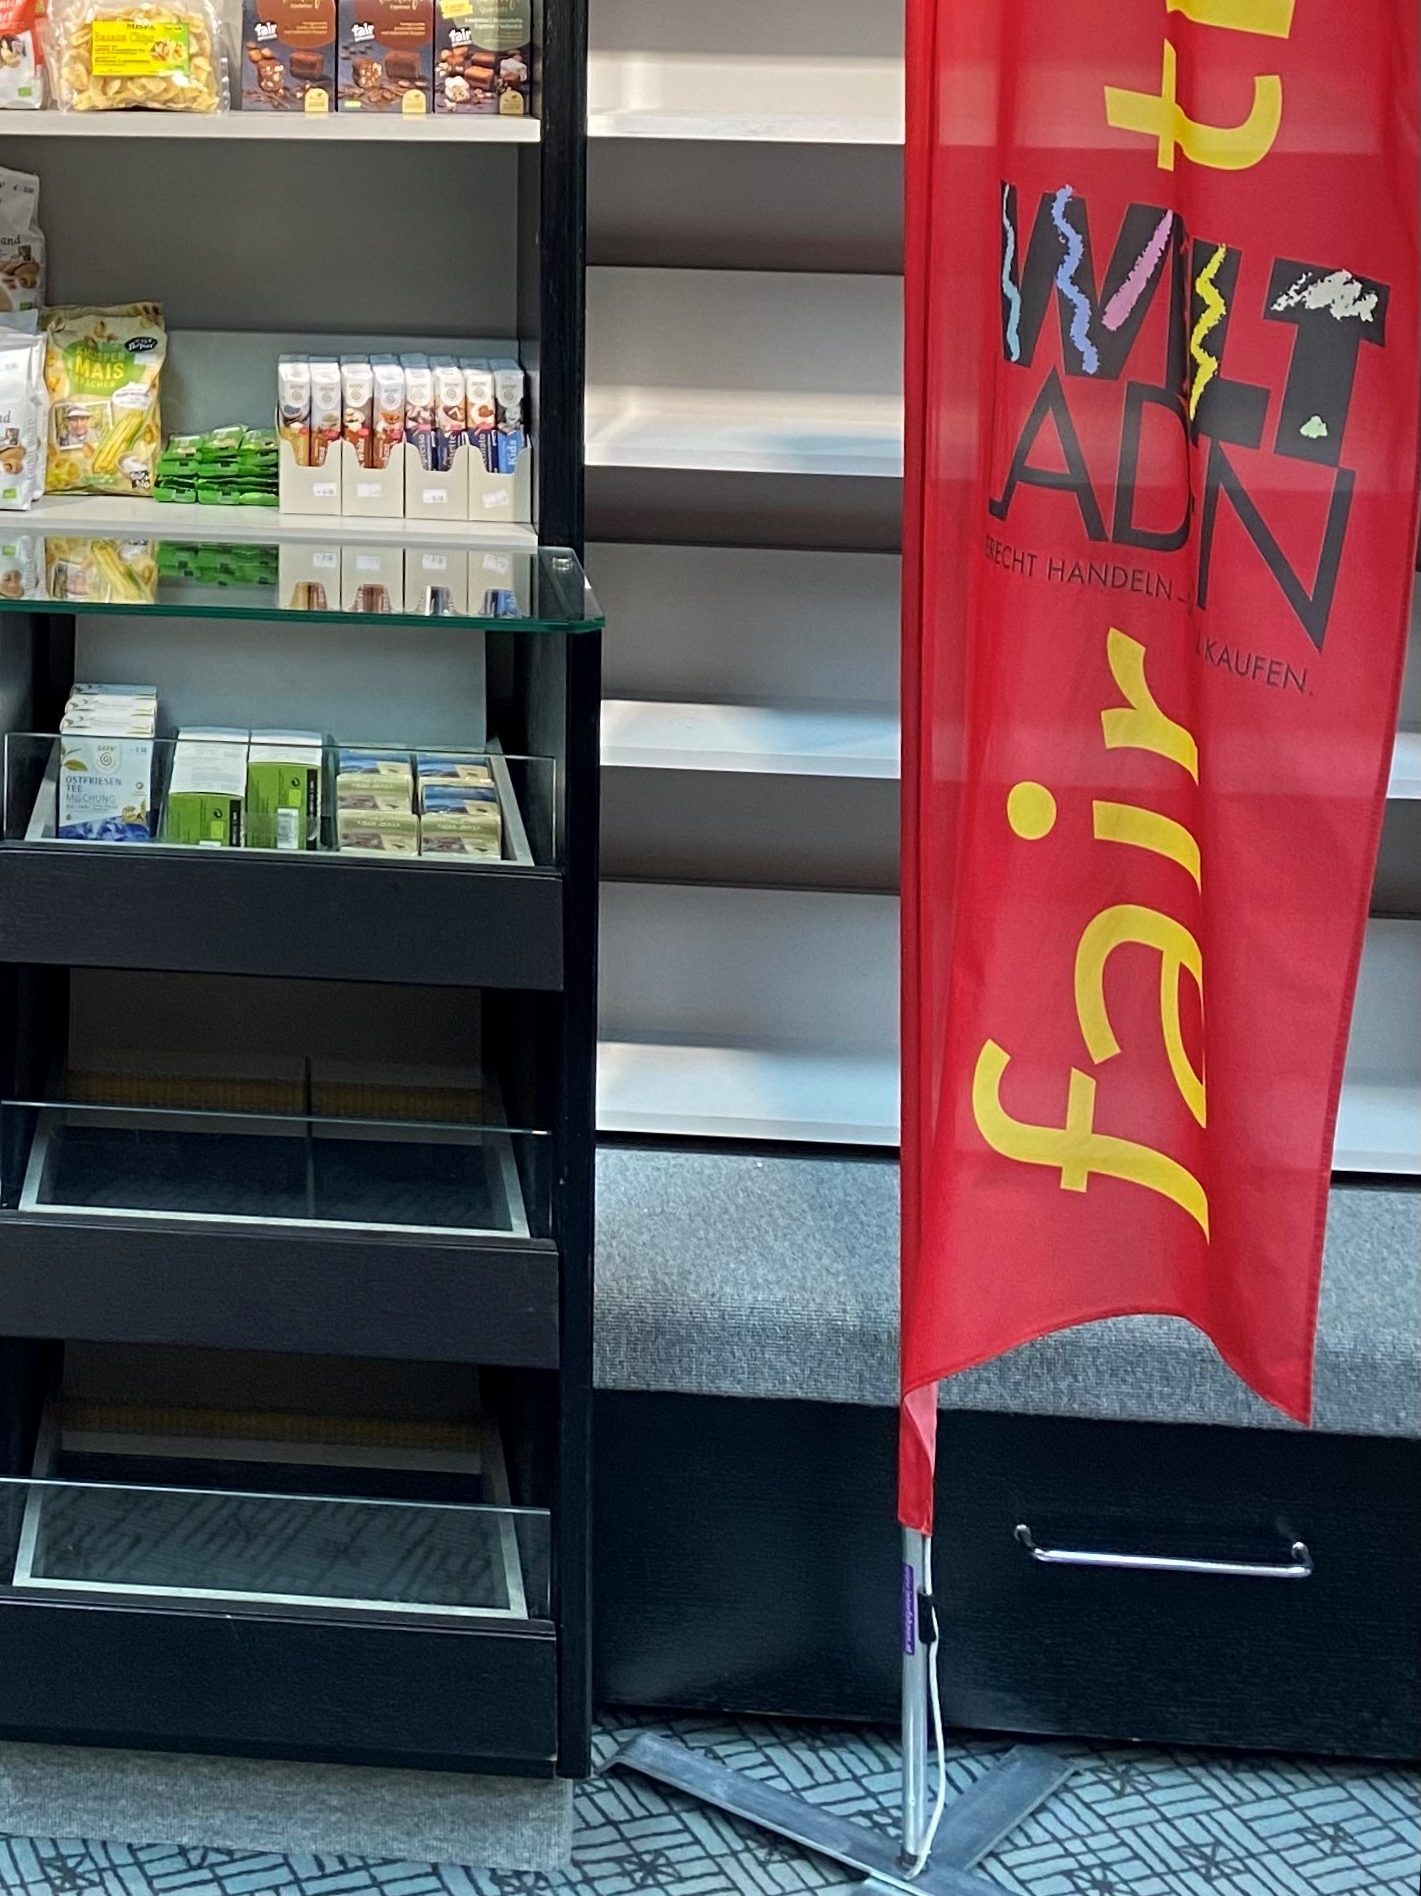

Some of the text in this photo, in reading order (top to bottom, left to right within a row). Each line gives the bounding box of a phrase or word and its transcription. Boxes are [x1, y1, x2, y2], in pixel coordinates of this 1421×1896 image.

[255, 22, 278, 36] fair
[351, 22, 375, 37] fair
[448, 27, 472, 43] fair
[1000, 179, 1391, 470] WLT
[75, 355, 125, 380] MAIS
[506, 439, 518, 466] Kids
[1204, 637, 1313, 696] KAUFEN.
[65, 775, 122, 786] OSTFRIESEN
[66, 785, 83, 793] TEE
[66, 793, 116, 803] MISCHUNG
[971, 627, 1211, 1245] fair
